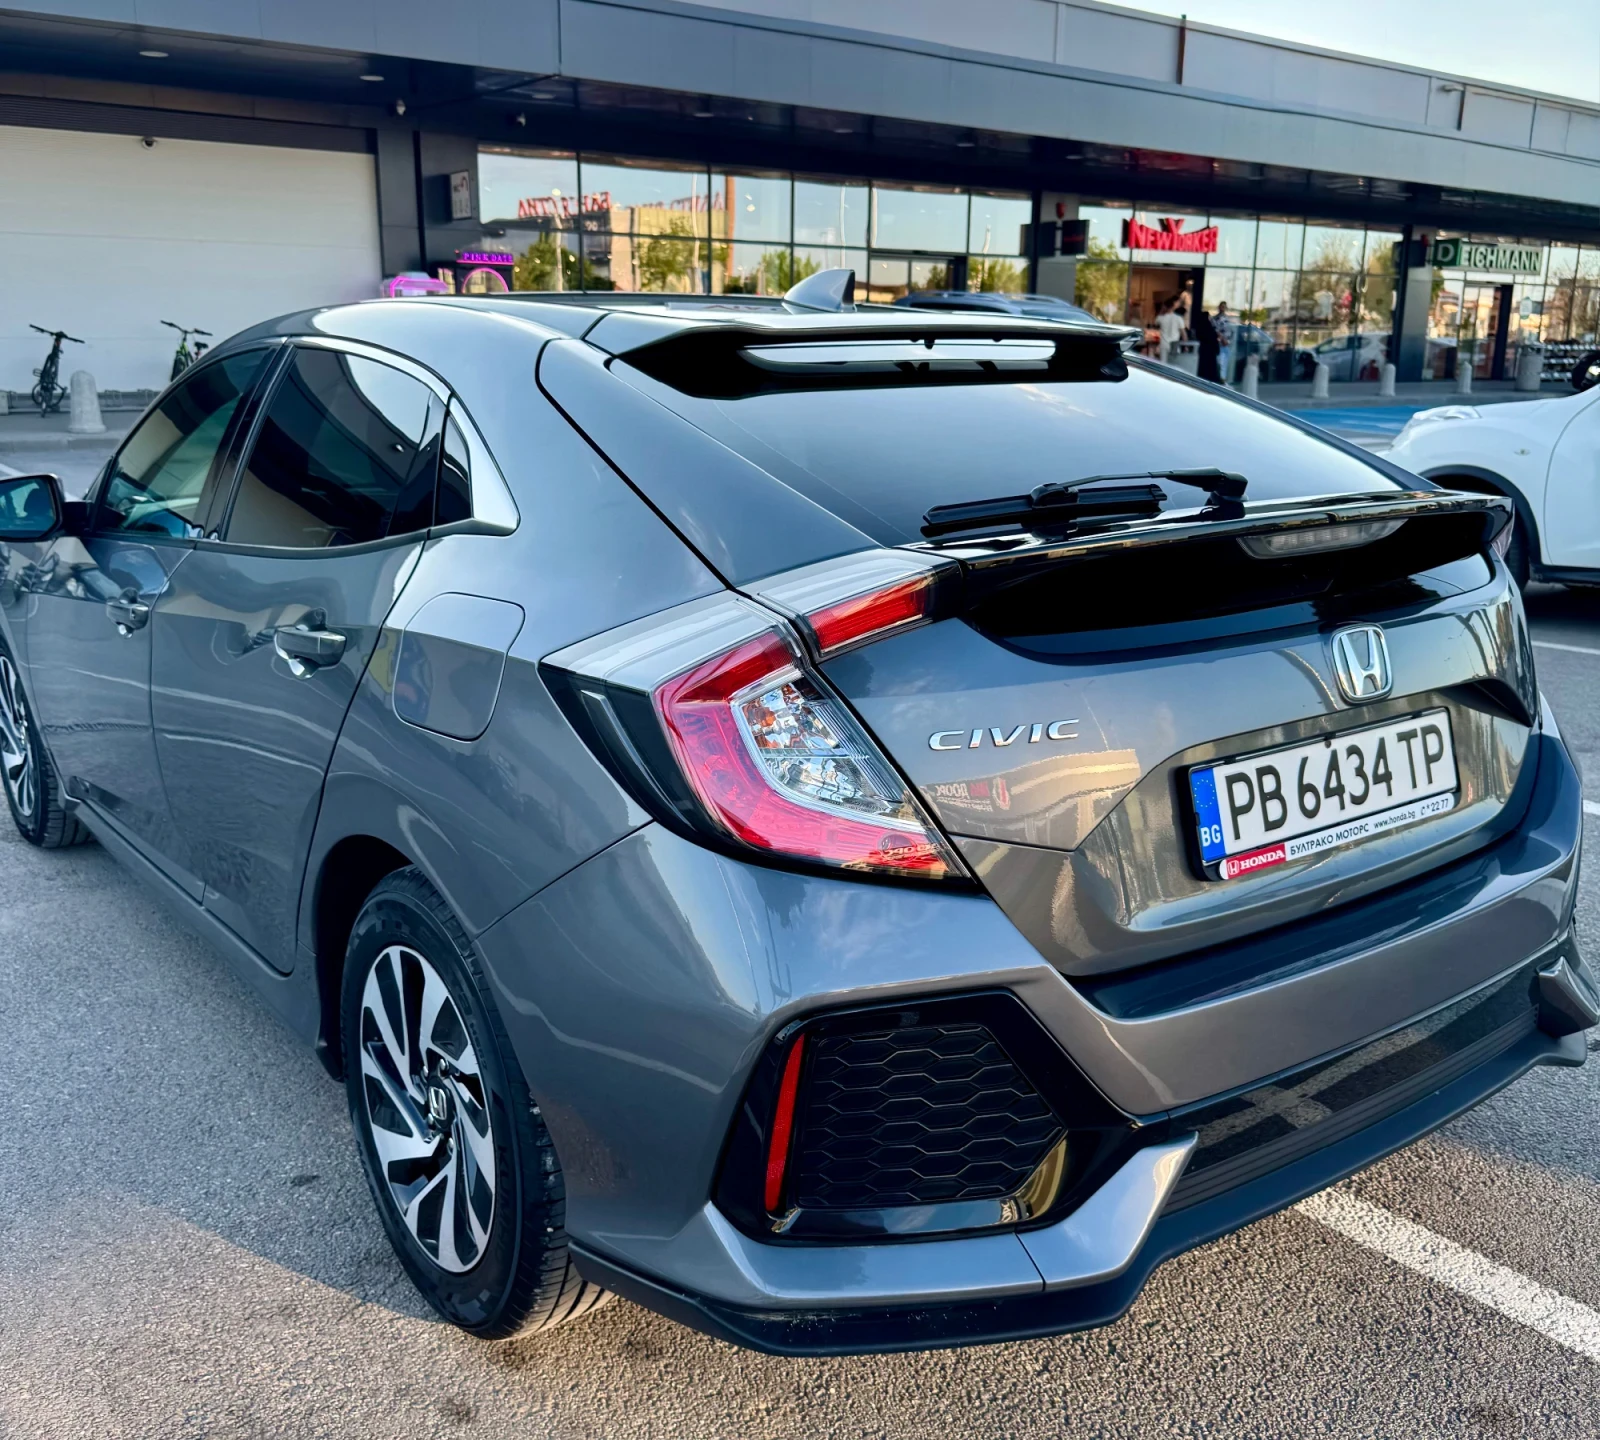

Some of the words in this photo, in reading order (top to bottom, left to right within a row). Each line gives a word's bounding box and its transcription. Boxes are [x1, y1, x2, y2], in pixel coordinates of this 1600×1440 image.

[929, 718, 1080, 750] CIVIC
[1225, 764, 1288, 840] PB
[1298, 737, 1393, 819] 6434
[1396, 724, 1444, 789] TP
[1373, 810, 1416, 829] www.honda.bg
[1200, 824, 1222, 848] BG
[1290, 835, 1334, 855] БУЛТРАКО
[1335, 823, 1369, 842] МОТОРС
[1240, 850, 1284, 870] HONDA
